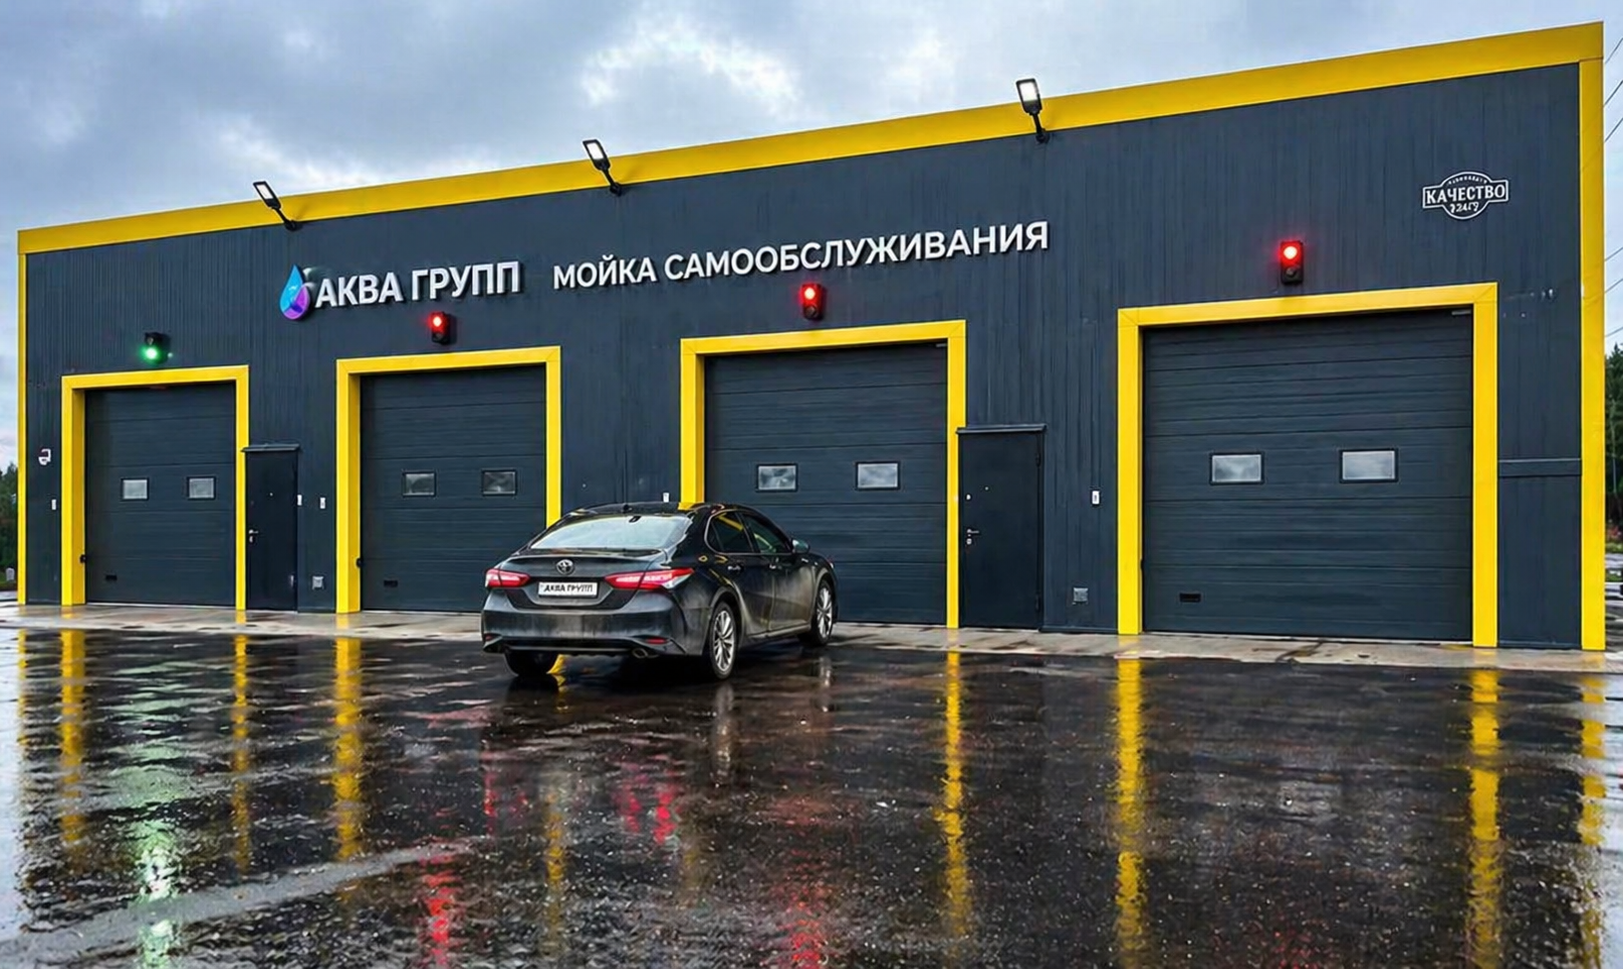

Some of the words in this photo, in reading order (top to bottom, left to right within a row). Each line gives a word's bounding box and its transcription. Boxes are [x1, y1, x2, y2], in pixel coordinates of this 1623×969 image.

[1426, 184, 1506, 204] КАЧЕСТВО
[553, 254, 657, 289] МОЙКА
[664, 221, 1048, 281] САМООБСЛУЖИВАНИЯ
[314, 272, 404, 308] АКВА
[411, 261, 520, 301] ГРУПП
